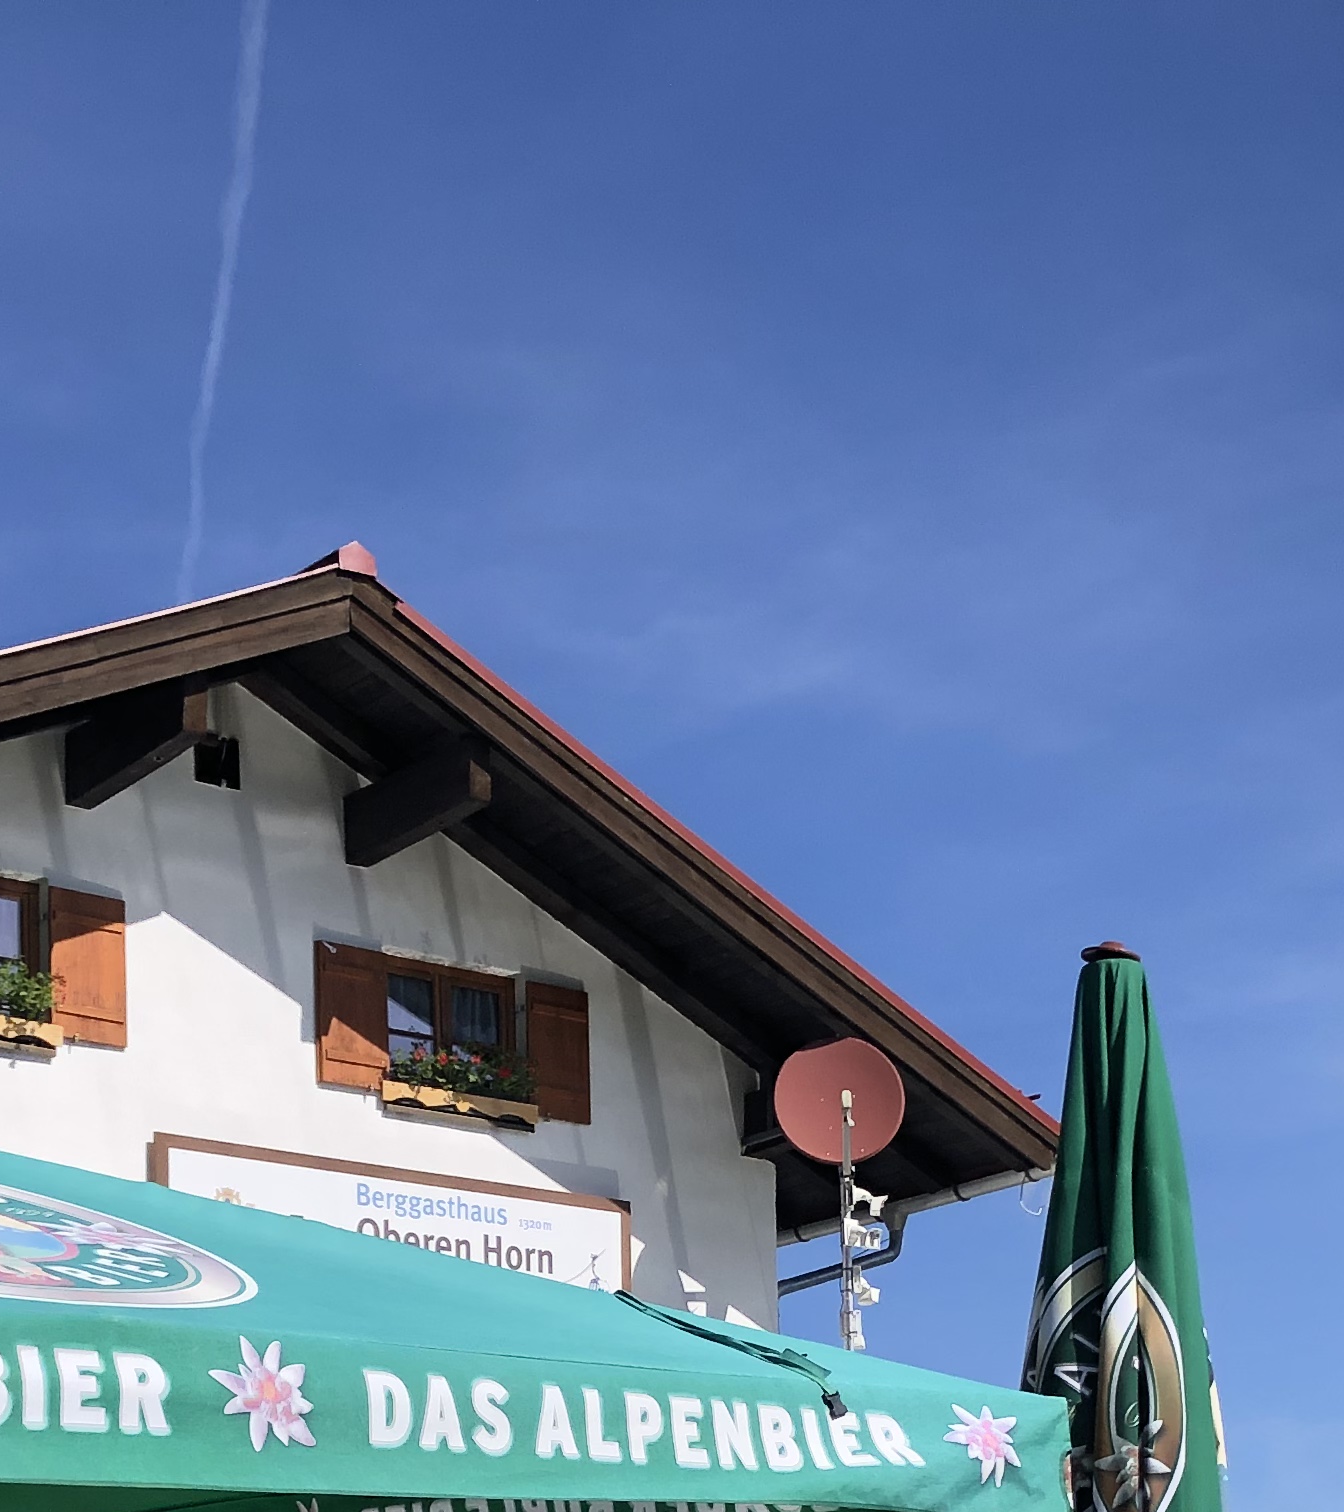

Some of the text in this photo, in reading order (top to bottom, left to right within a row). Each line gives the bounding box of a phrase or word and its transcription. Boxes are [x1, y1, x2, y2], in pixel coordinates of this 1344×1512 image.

[356, 1182, 508, 1226] Berggasthaus
[42, 1247, 170, 1286] BIER
[482, 1233, 554, 1275] Horn
[362, 1368, 511, 1456] DAS
[535, 1383, 927, 1473] ALPENBIER
